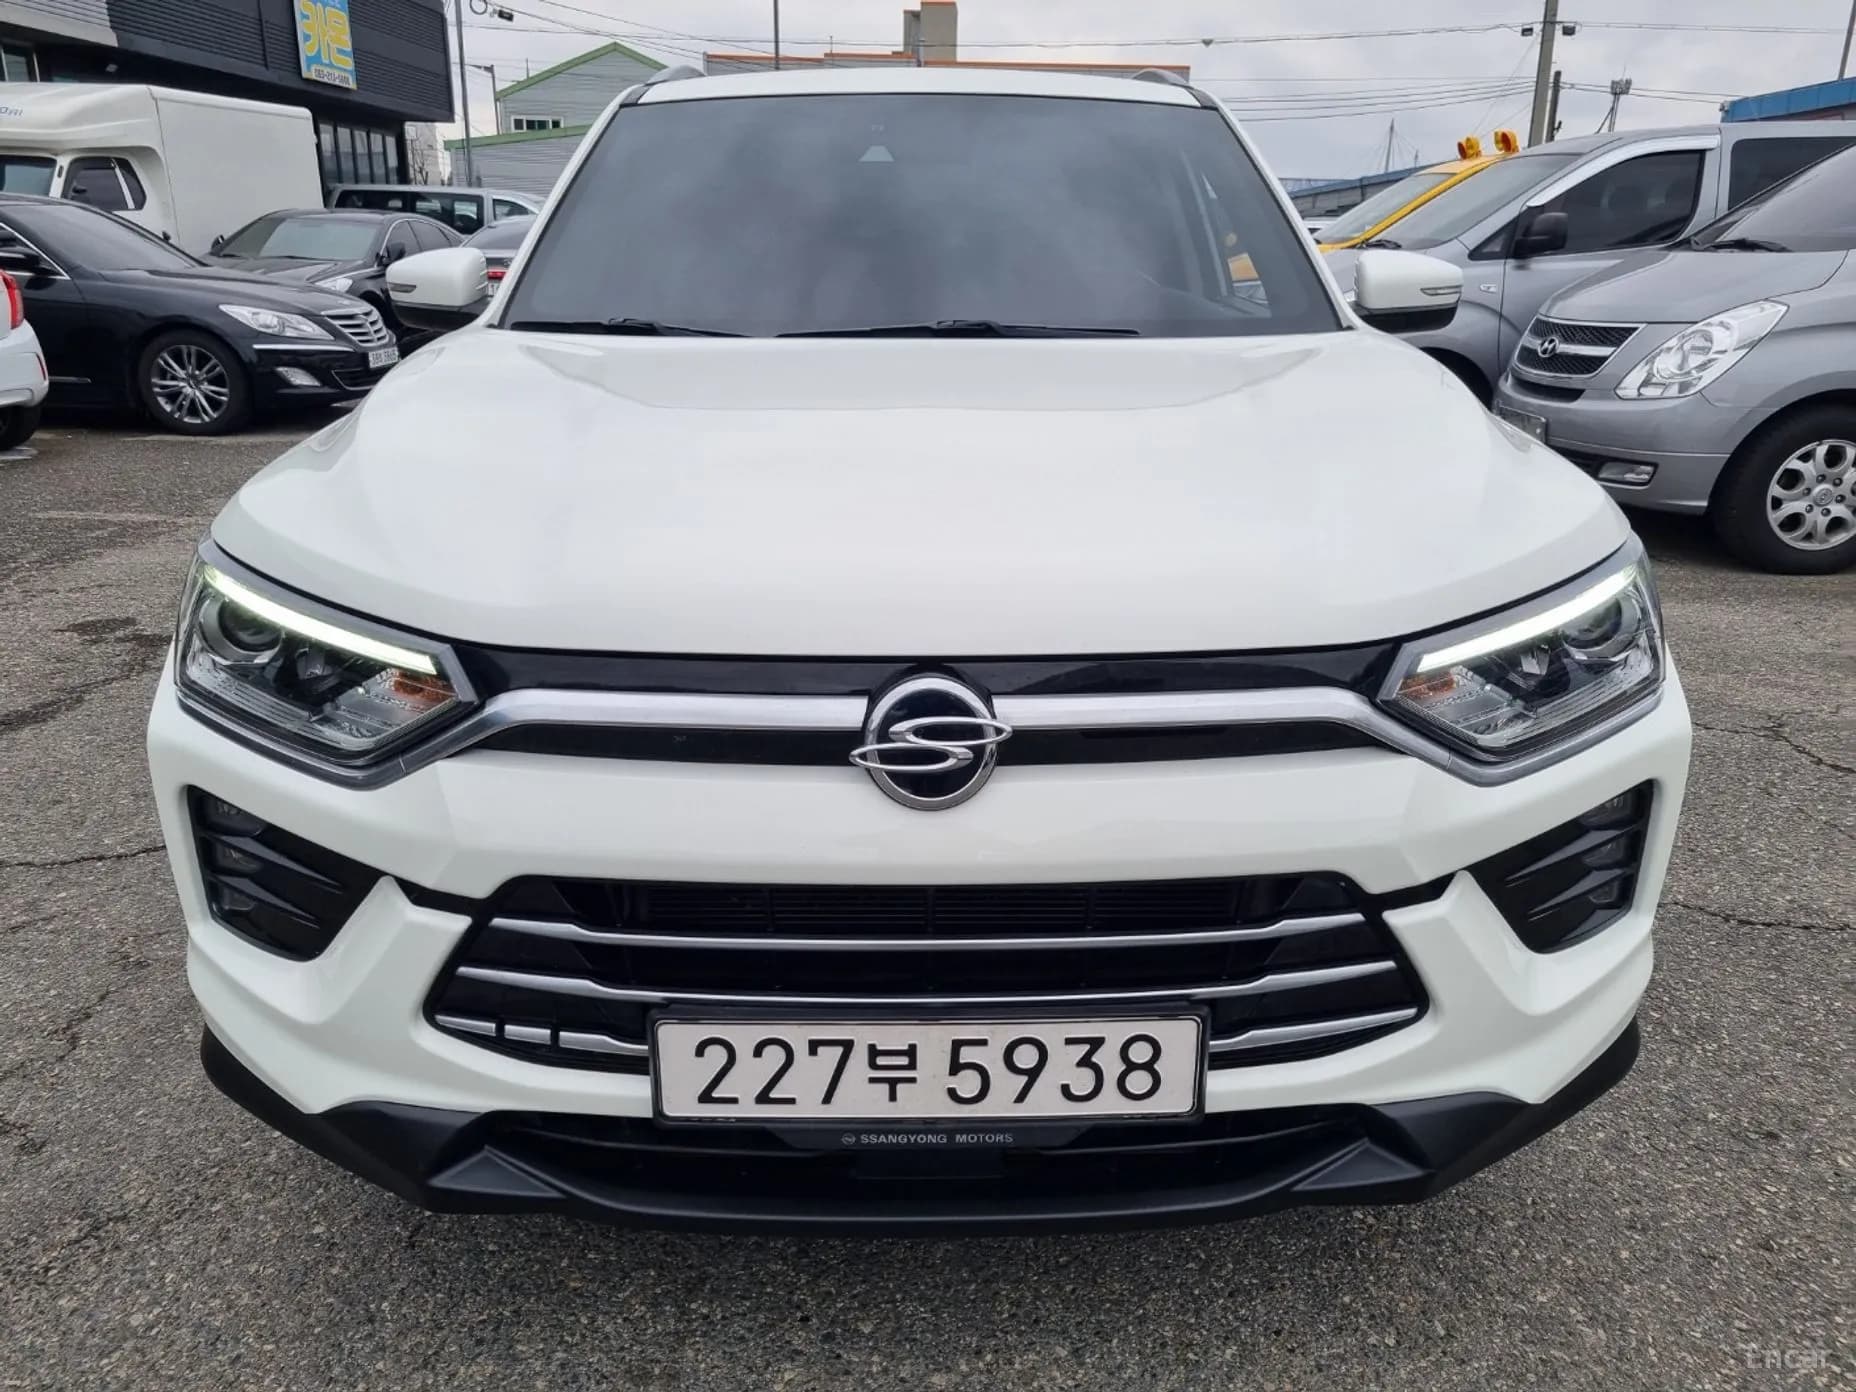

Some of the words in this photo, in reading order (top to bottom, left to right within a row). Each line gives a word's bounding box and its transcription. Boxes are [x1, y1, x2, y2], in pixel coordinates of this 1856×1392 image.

[694, 1036, 918, 1105] 227부
[946, 1033, 1162, 1105] 5938
[860, 1133, 948, 1144] SSANGYONG
[955, 1132, 1014, 1144] MOTORS
